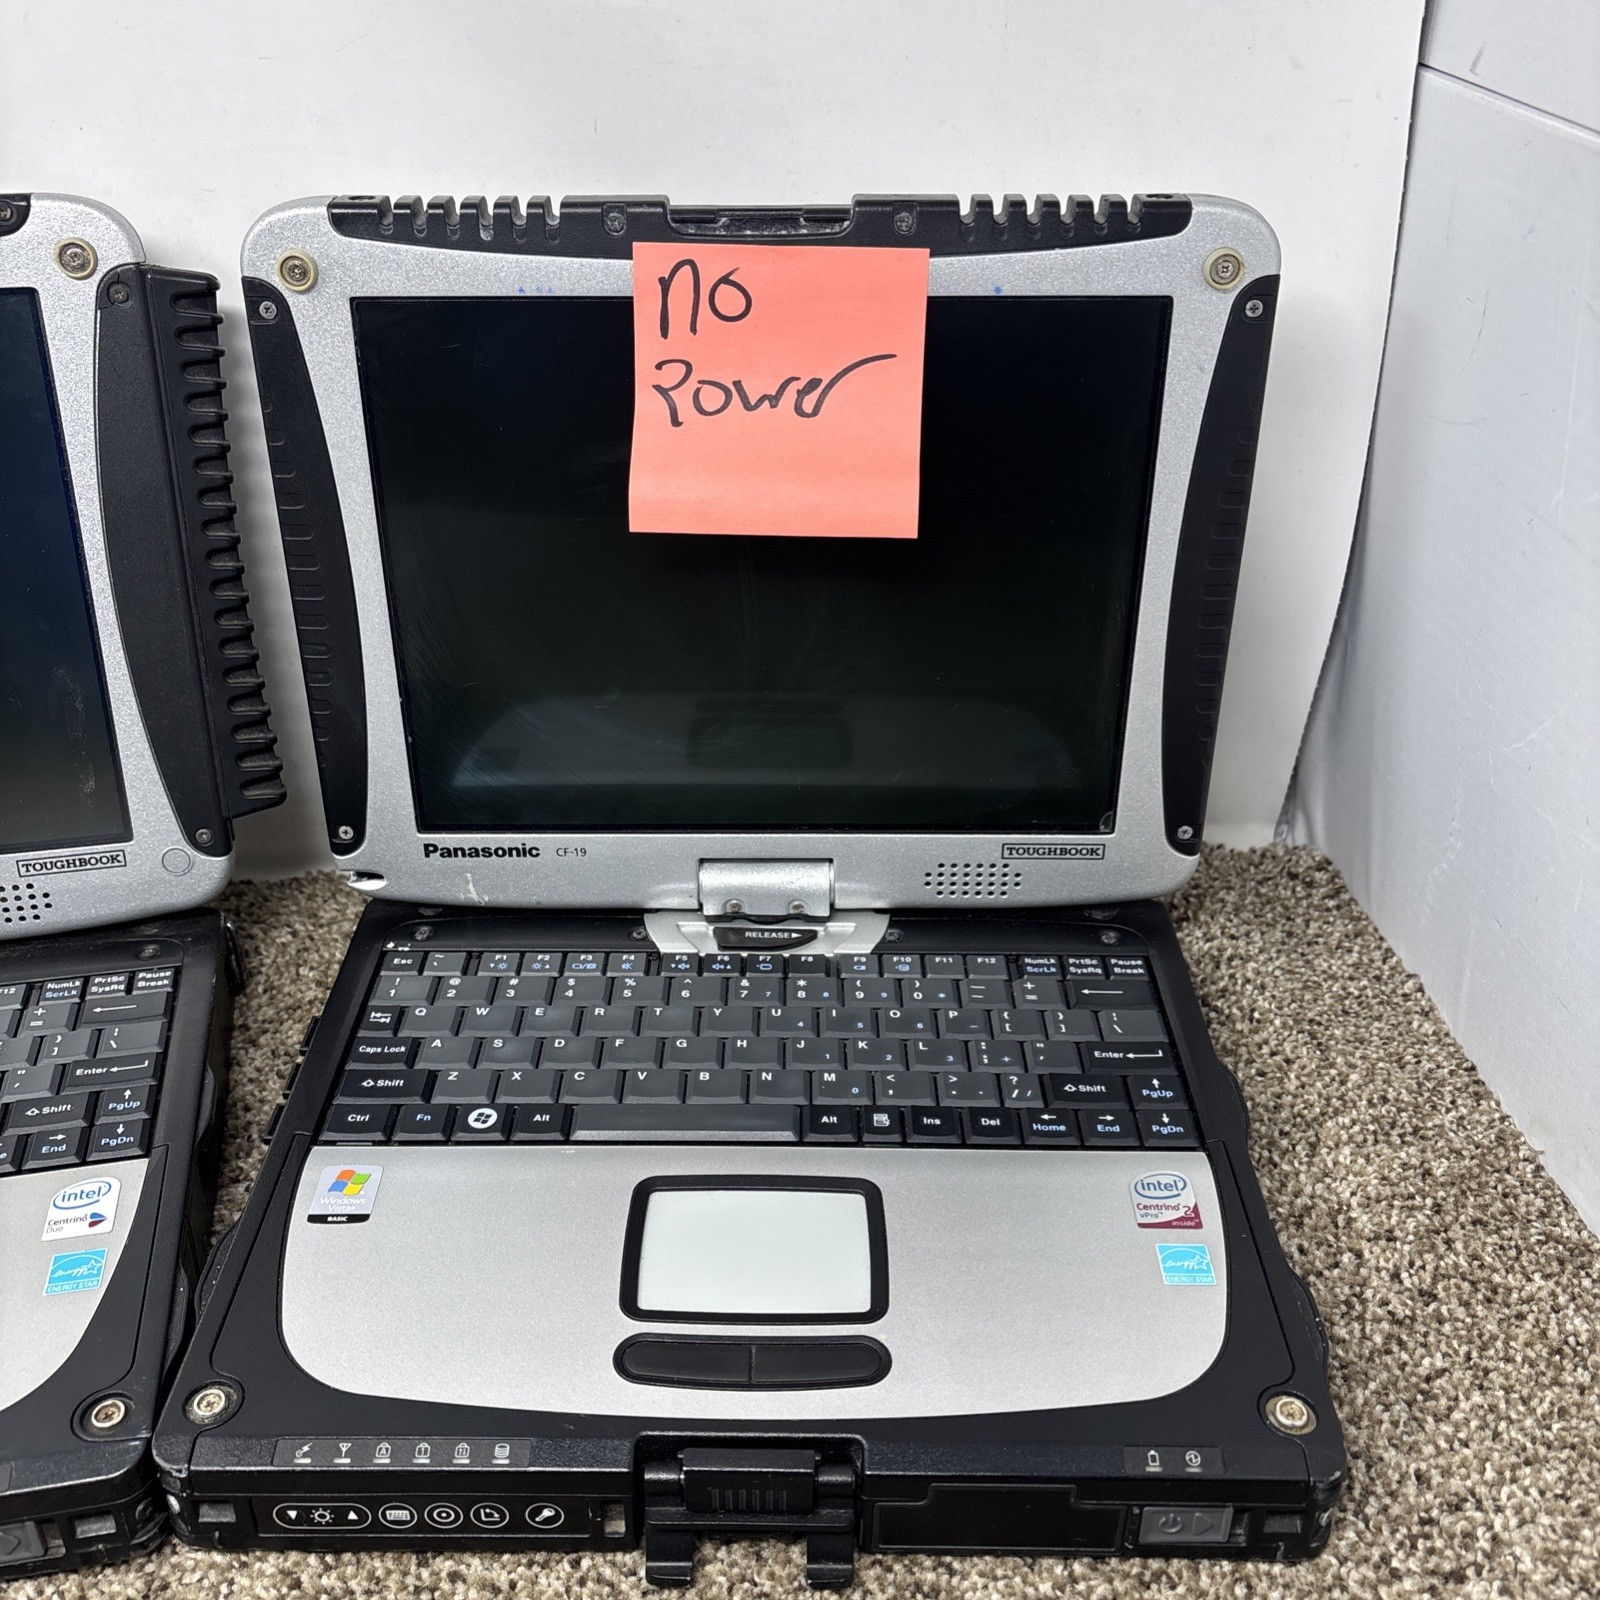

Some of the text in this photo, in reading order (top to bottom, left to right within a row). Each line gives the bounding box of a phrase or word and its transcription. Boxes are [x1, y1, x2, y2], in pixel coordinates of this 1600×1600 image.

[423, 843, 587, 859] Panasonic CF-19
[1006, 847, 1101, 856] TOUGHBOOK
[21, 854, 122, 873] TOUGHBOOK
[745, 931, 790, 939] RELEASE
[47, 981, 80, 989] NumLk
[138, 979, 168, 987] Break
[91, 984, 124, 993] SysRq
[45, 990, 77, 998] ScrLk
[390, 989, 395, 997] 1
[447, 989, 456, 997] 2
[506, 989, 515, 997] 3
[415, 1008, 426, 1016] Q
[714, 1008, 722, 1016] Y
[890, 1010, 900, 1018] O
[431, 1039, 441, 1047] A
[493, 1039, 503, 1047] S
[555, 1039, 565, 1047] D
[615, 1039, 624, 1047] F
[676, 1039, 687, 1047] G
[797, 1040, 804, 1048] J
[858, 1041, 868, 1049] K
[919, 1042, 927, 1050] L
[359, 1045, 406, 1054] Caps Lock
[76, 1066, 108, 1075] Enter
[448, 1072, 458, 1080] Z
[512, 1072, 522, 1080] X
[574, 1072, 585, 1080] C
[638, 1072, 647, 1080] V
[700, 1072, 709, 1080] B
[762, 1072, 772, 1080] N
[824, 1073, 835, 1081] M
[1142, 1090, 1173, 1098] PgUp
[42, 1105, 71, 1114] Shift
[109, 1101, 140, 1110] PgUp
[1152, 1125, 1183, 1134] PgDn
[101, 1134, 134, 1147] PgDn
[42, 1144, 66, 1153] End
[1140, 1179, 1179, 1192] intel
[62, 1186, 101, 1202] intel
[320, 1197, 366, 1205] Windows
[1183, 1205, 1195, 1217] 2
[46, 1226, 63, 1234] Duo
[47, 1280, 98, 1293] ENERGY STAR
